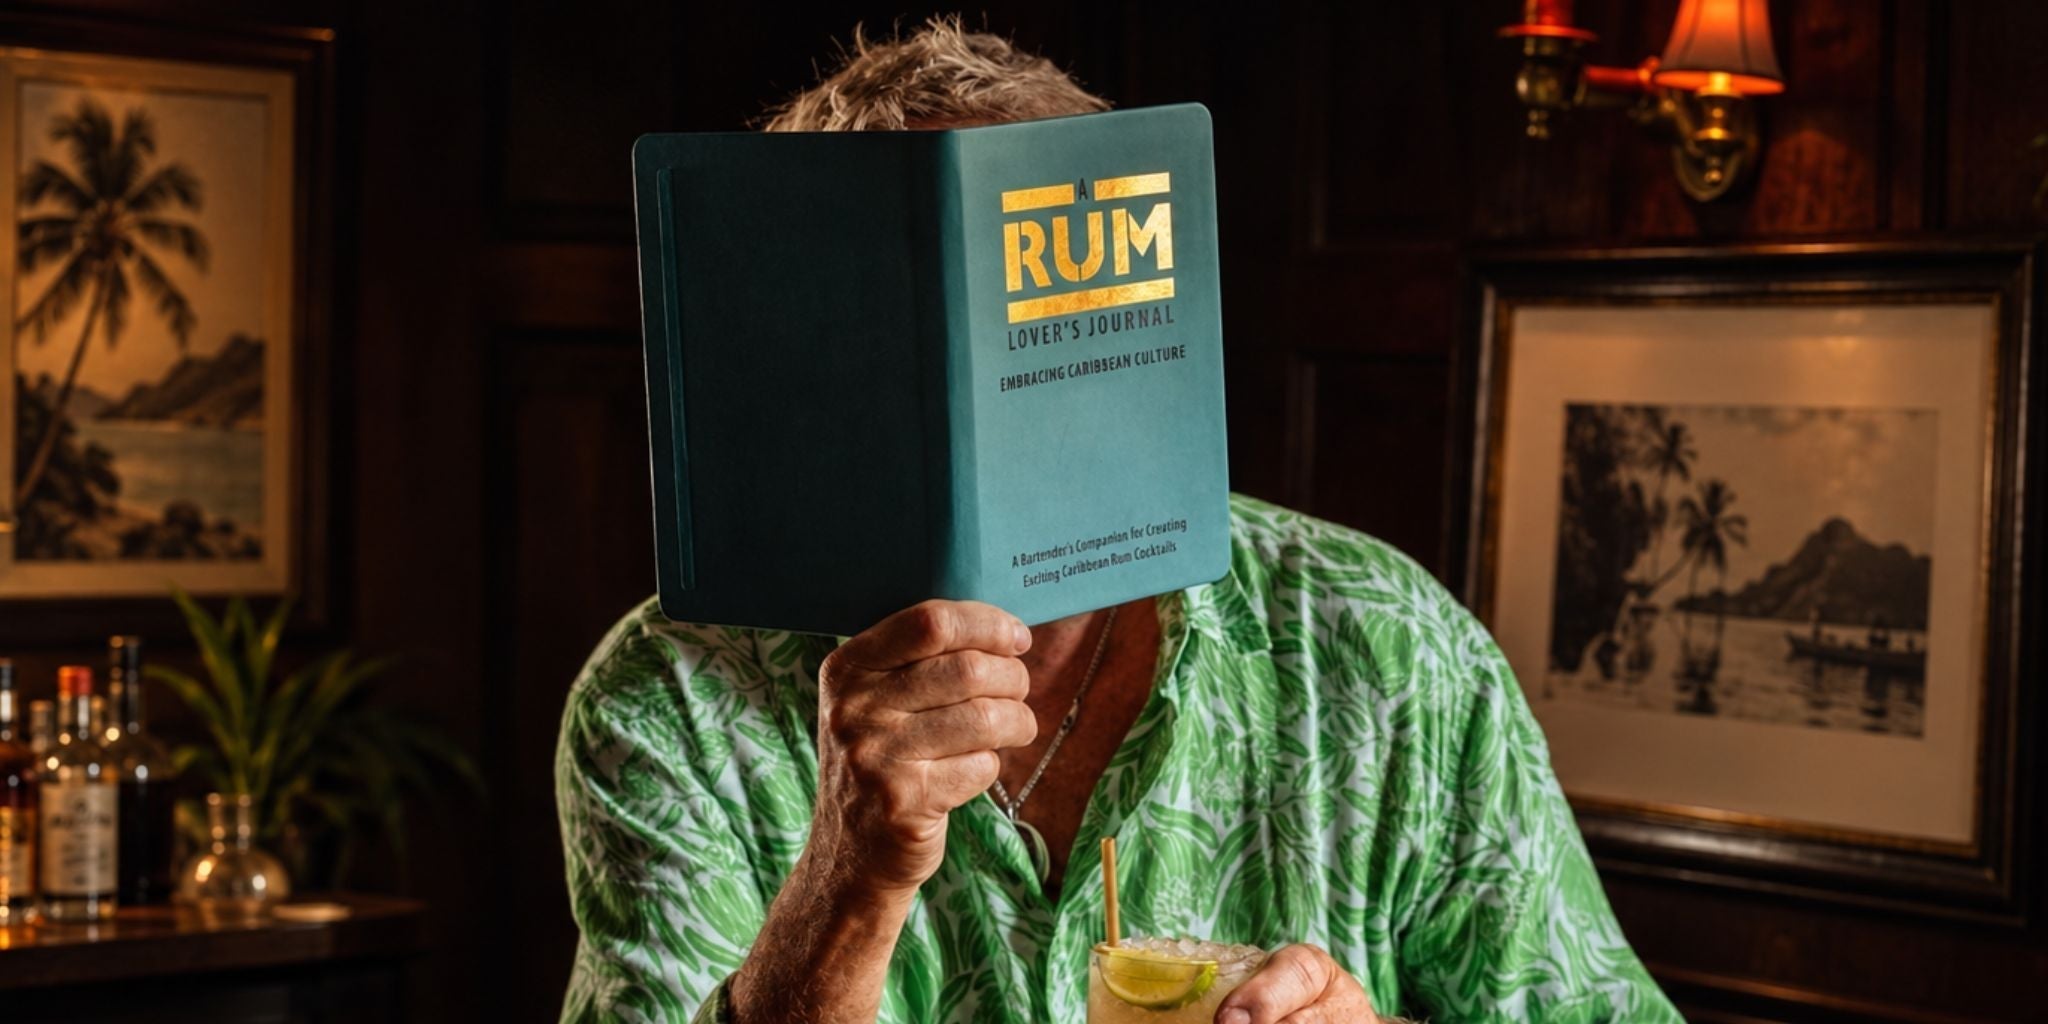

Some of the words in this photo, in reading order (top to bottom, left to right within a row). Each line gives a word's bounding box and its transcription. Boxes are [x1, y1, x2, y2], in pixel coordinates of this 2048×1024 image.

[1078, 177, 1088, 200] A
[1003, 202, 1174, 293] RUM
[1008, 320, 1080, 351] LOVER'S
[1088, 304, 1174, 337] JOURNAL
[1000, 366, 1064, 392] EMBRACING
[1068, 354, 1131, 378] CARIBBEAN
[1135, 345, 1186, 367] CULTURE
[1012, 555, 1019, 568] A
[1021, 543, 1074, 566] Bartender's
[1076, 531, 1128, 552] Companion
[1130, 526, 1144, 540] for
[1146, 518, 1187, 537] Creating
[1023, 568, 1060, 587] Exciting
[1062, 557, 1109, 578] Caribbean
[1111, 552, 1132, 566] Rum
[1134, 541, 1177, 561] Cocktails
